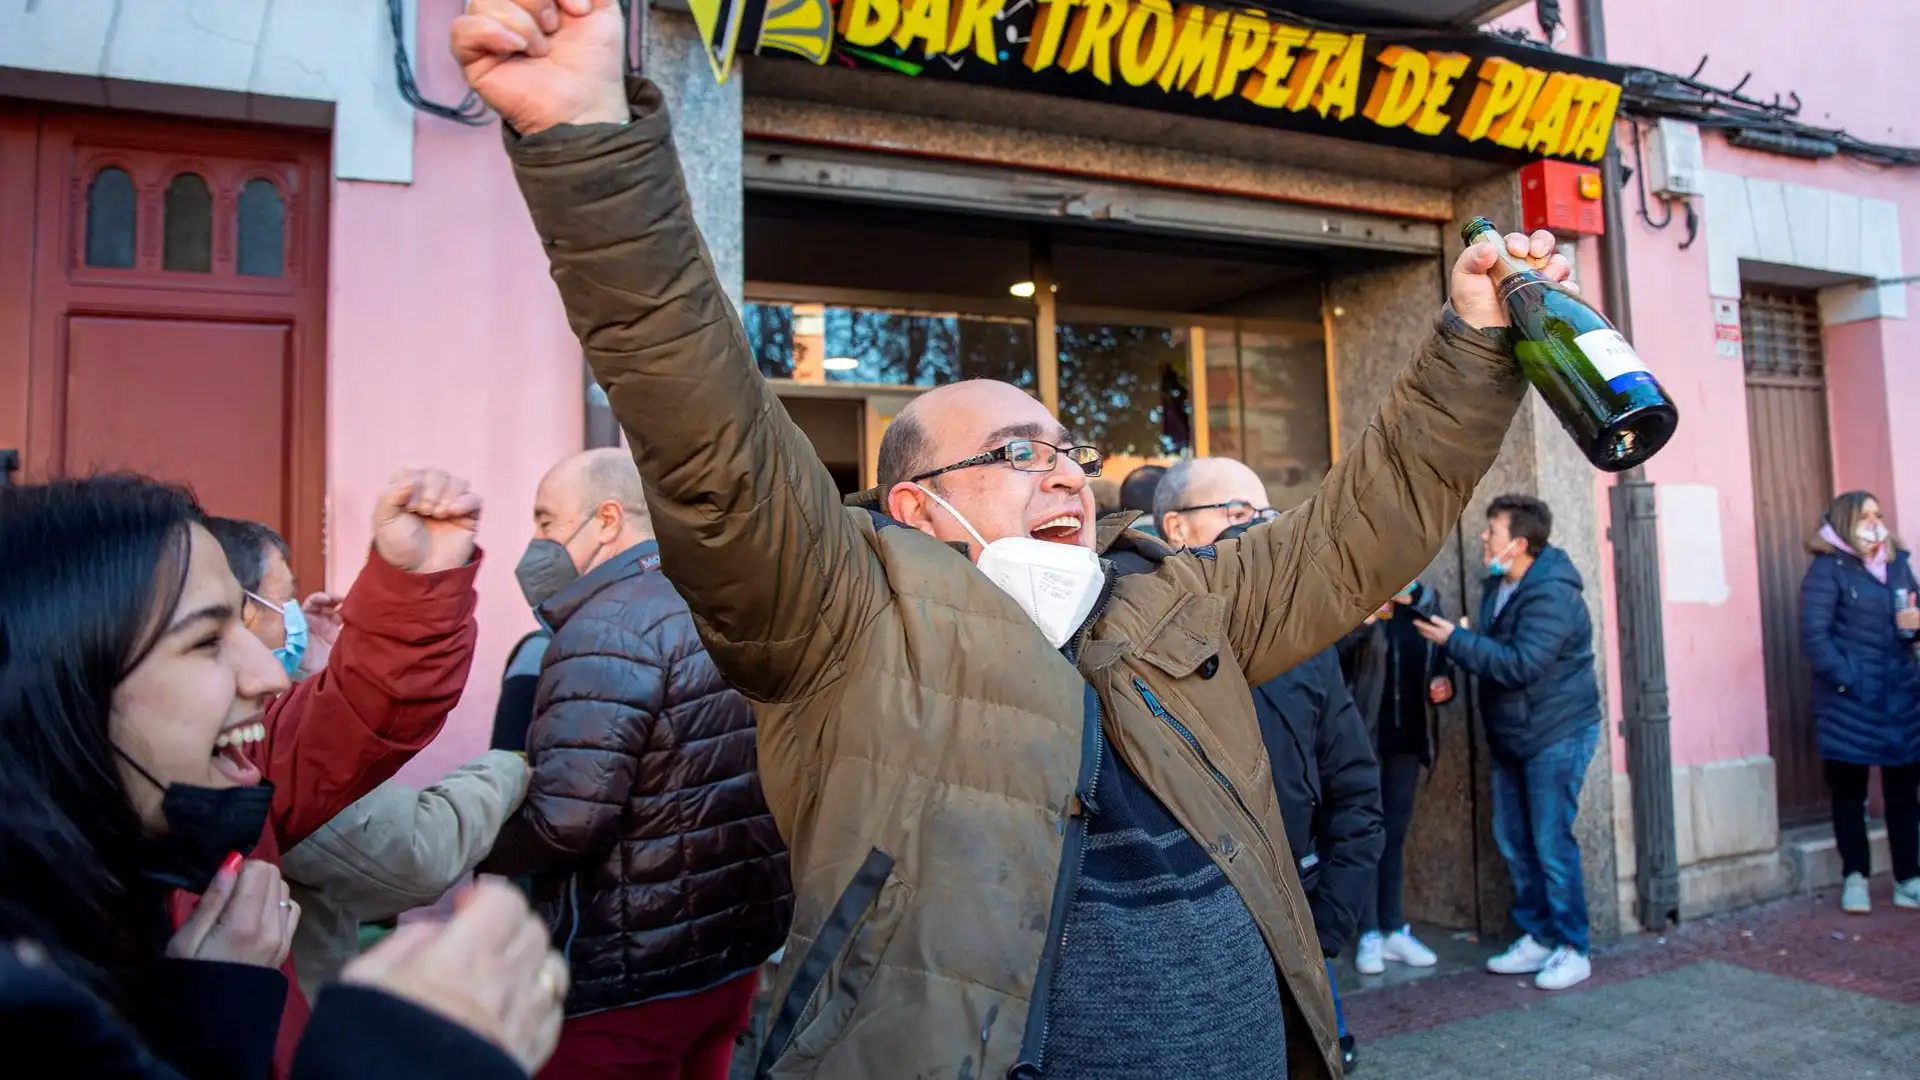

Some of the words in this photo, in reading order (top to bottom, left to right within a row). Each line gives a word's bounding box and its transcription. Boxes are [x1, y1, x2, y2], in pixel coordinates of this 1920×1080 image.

[839, 0, 1004, 66] BAR
[1024, 0, 1367, 122] TROMPETA
[1364, 46, 1472, 136] DE
[1458, 57, 1623, 162] PLATA
